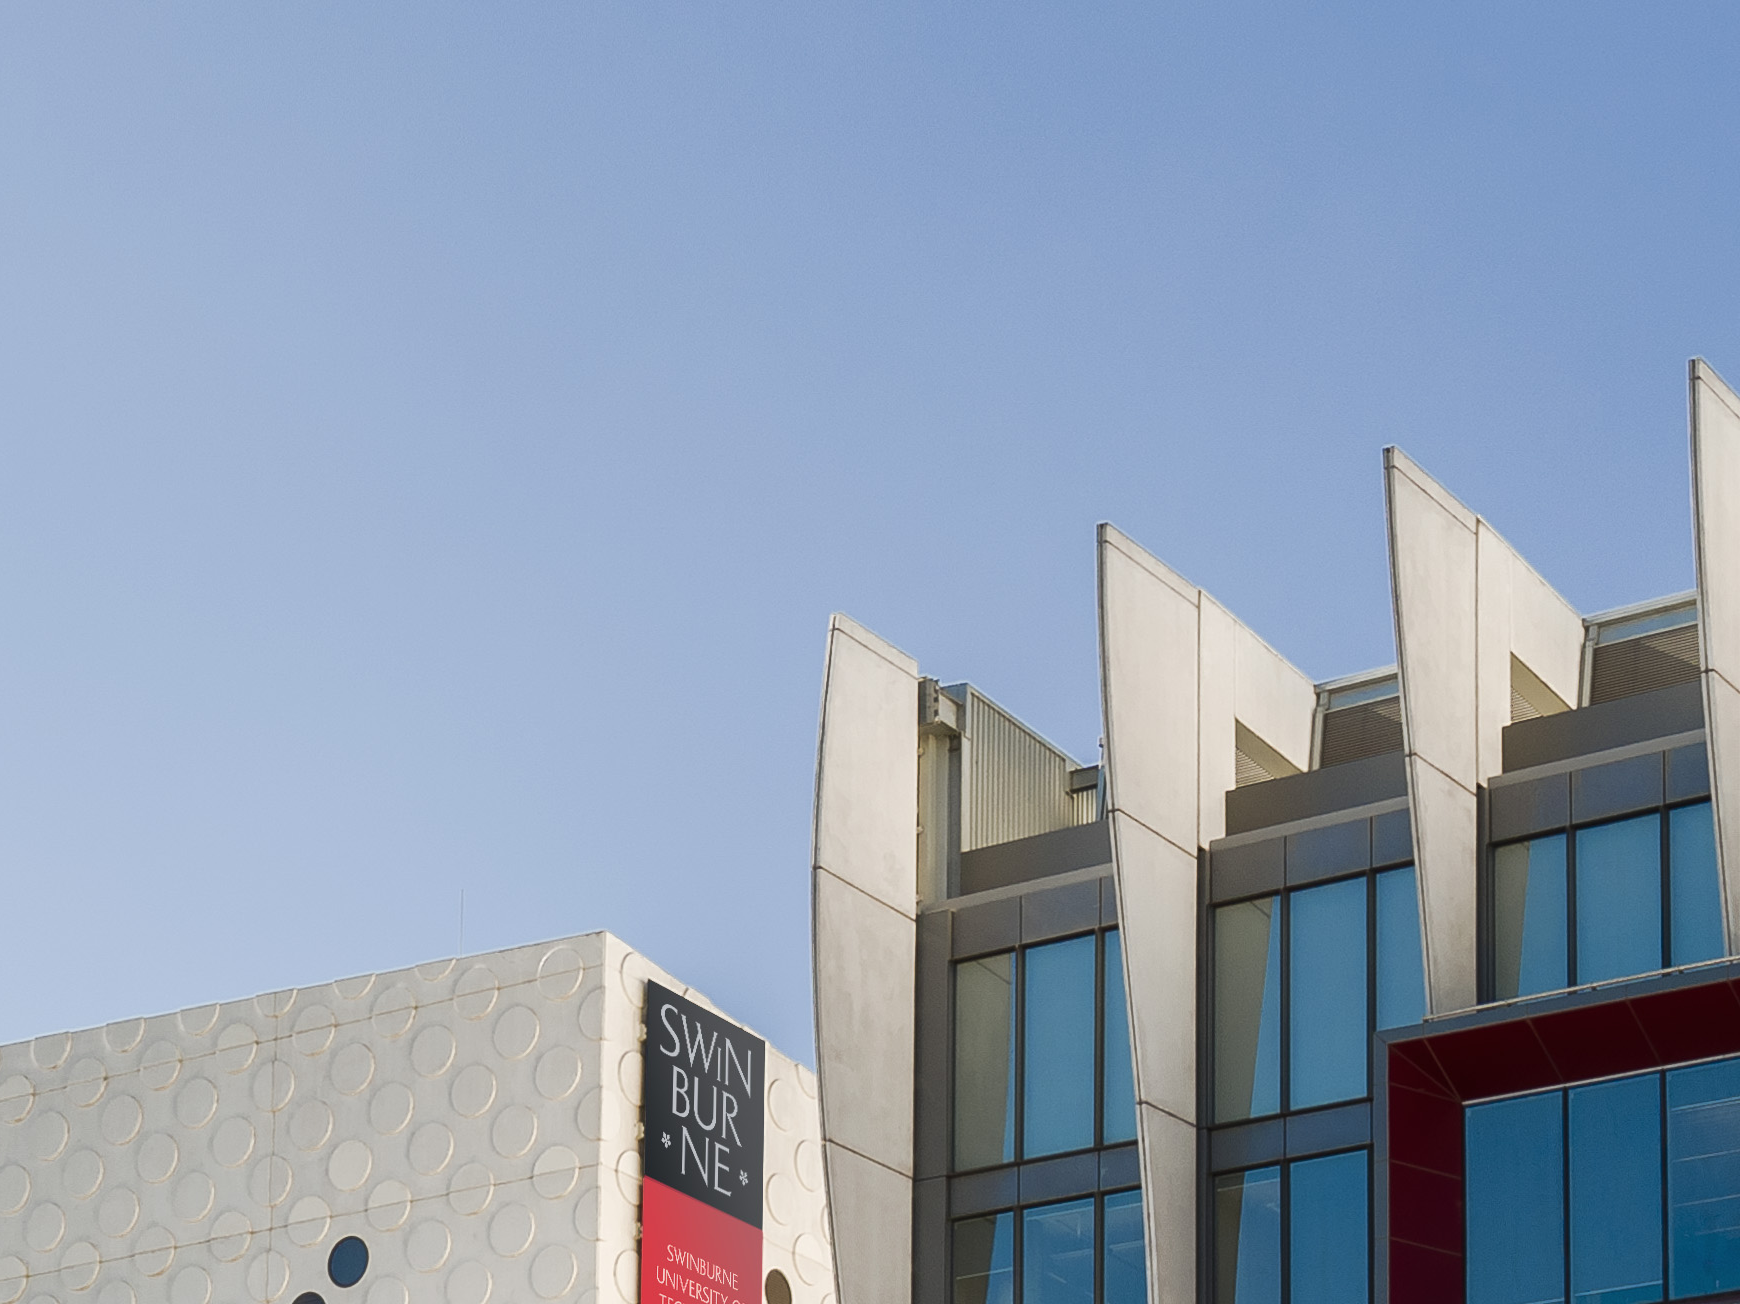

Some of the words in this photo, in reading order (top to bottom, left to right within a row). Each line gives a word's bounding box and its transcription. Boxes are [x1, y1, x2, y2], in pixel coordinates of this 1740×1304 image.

[660, 1003, 752, 1099] SWIN
[672, 1065, 742, 1147] BUR
[681, 1125, 732, 1197] NE
[666, 1244, 739, 1290] SWINBURNE
